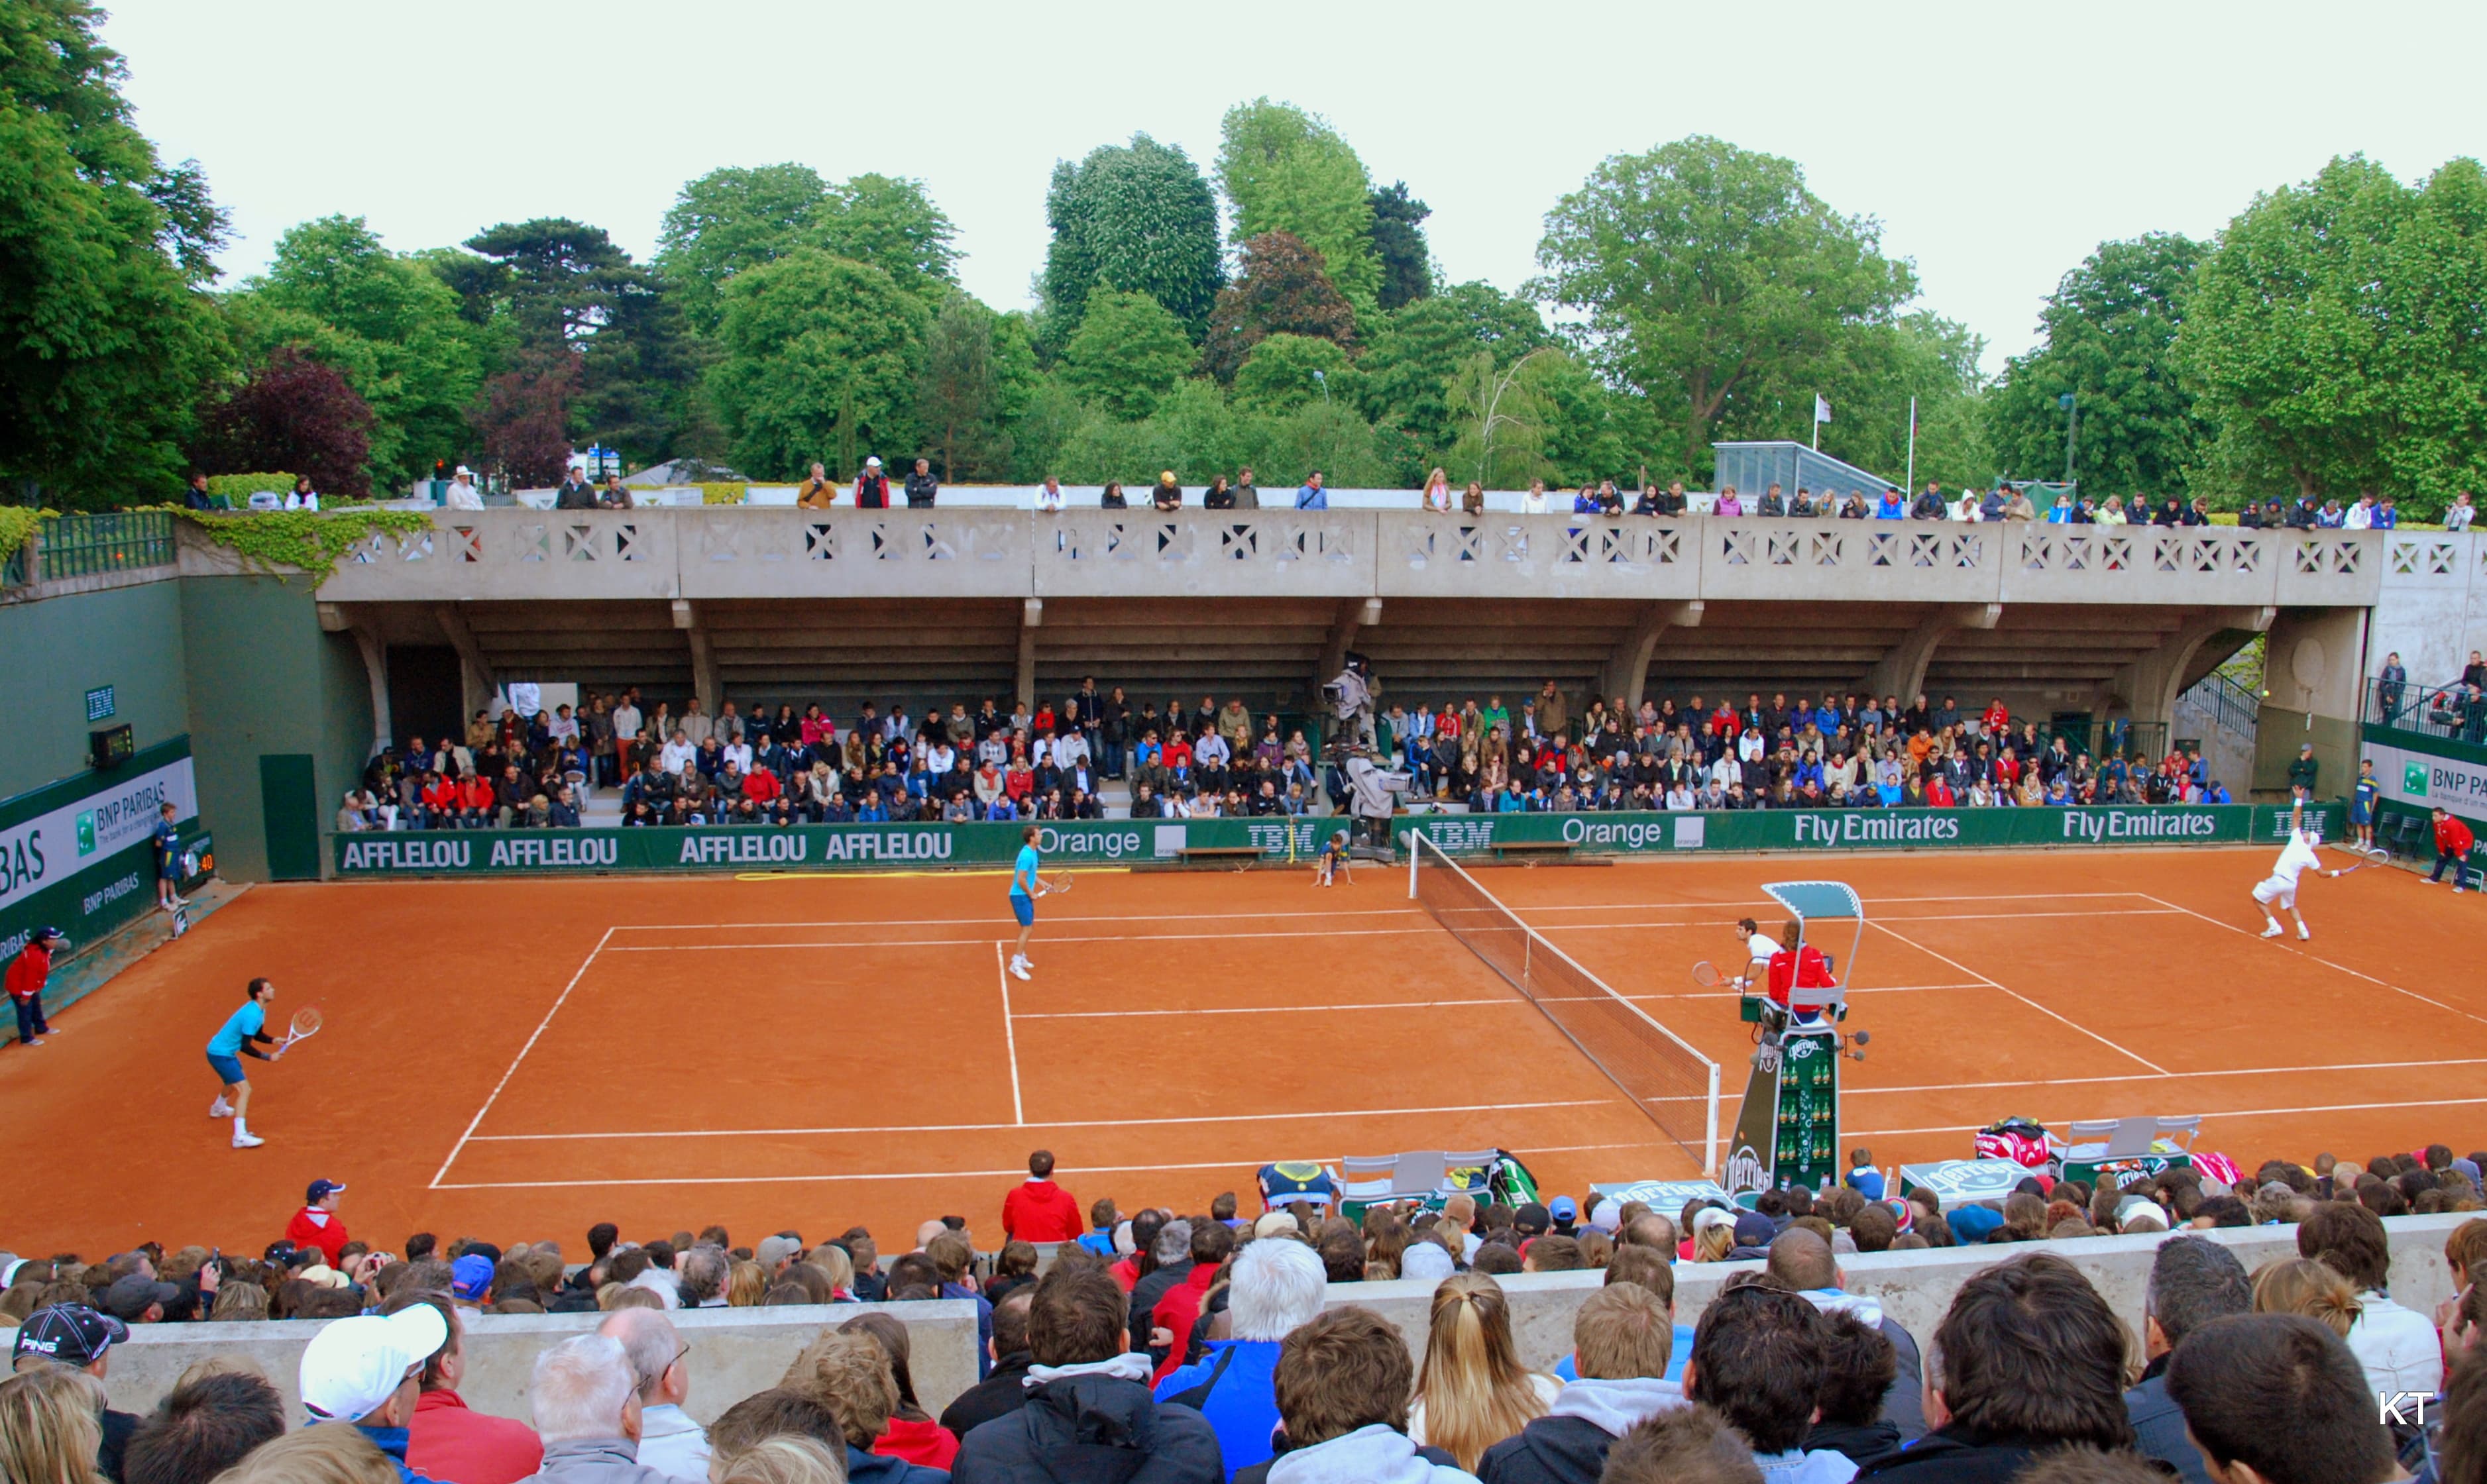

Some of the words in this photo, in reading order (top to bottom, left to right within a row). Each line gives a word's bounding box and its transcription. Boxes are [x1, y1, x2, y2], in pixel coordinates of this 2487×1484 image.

[2433, 768, 2466, 791] BNP
[96, 802, 121, 831] BNP
[122, 781, 165, 821] PARIBAS
[1247, 824, 1315, 853] IBM
[1429, 822, 1494, 849] IBM
[1563, 818, 1661, 848] Orange
[1795, 814, 1840, 846] Fly
[1844, 812, 1959, 840] Emirates
[2064, 810, 2105, 842] Fly
[2109, 809, 2215, 836] Emirates
[343, 840, 470, 869] AFFLELOU
[490, 838, 617, 866] AFFLELOU
[680, 835, 807, 863] AFFLELOU
[826, 832, 952, 861] AFFLELOU
[1037, 827, 1140, 858] Orange
[83, 891, 103, 916] BNP
[103, 871, 139, 905] PARIBAS
[21, 1338, 58, 1352] PING
